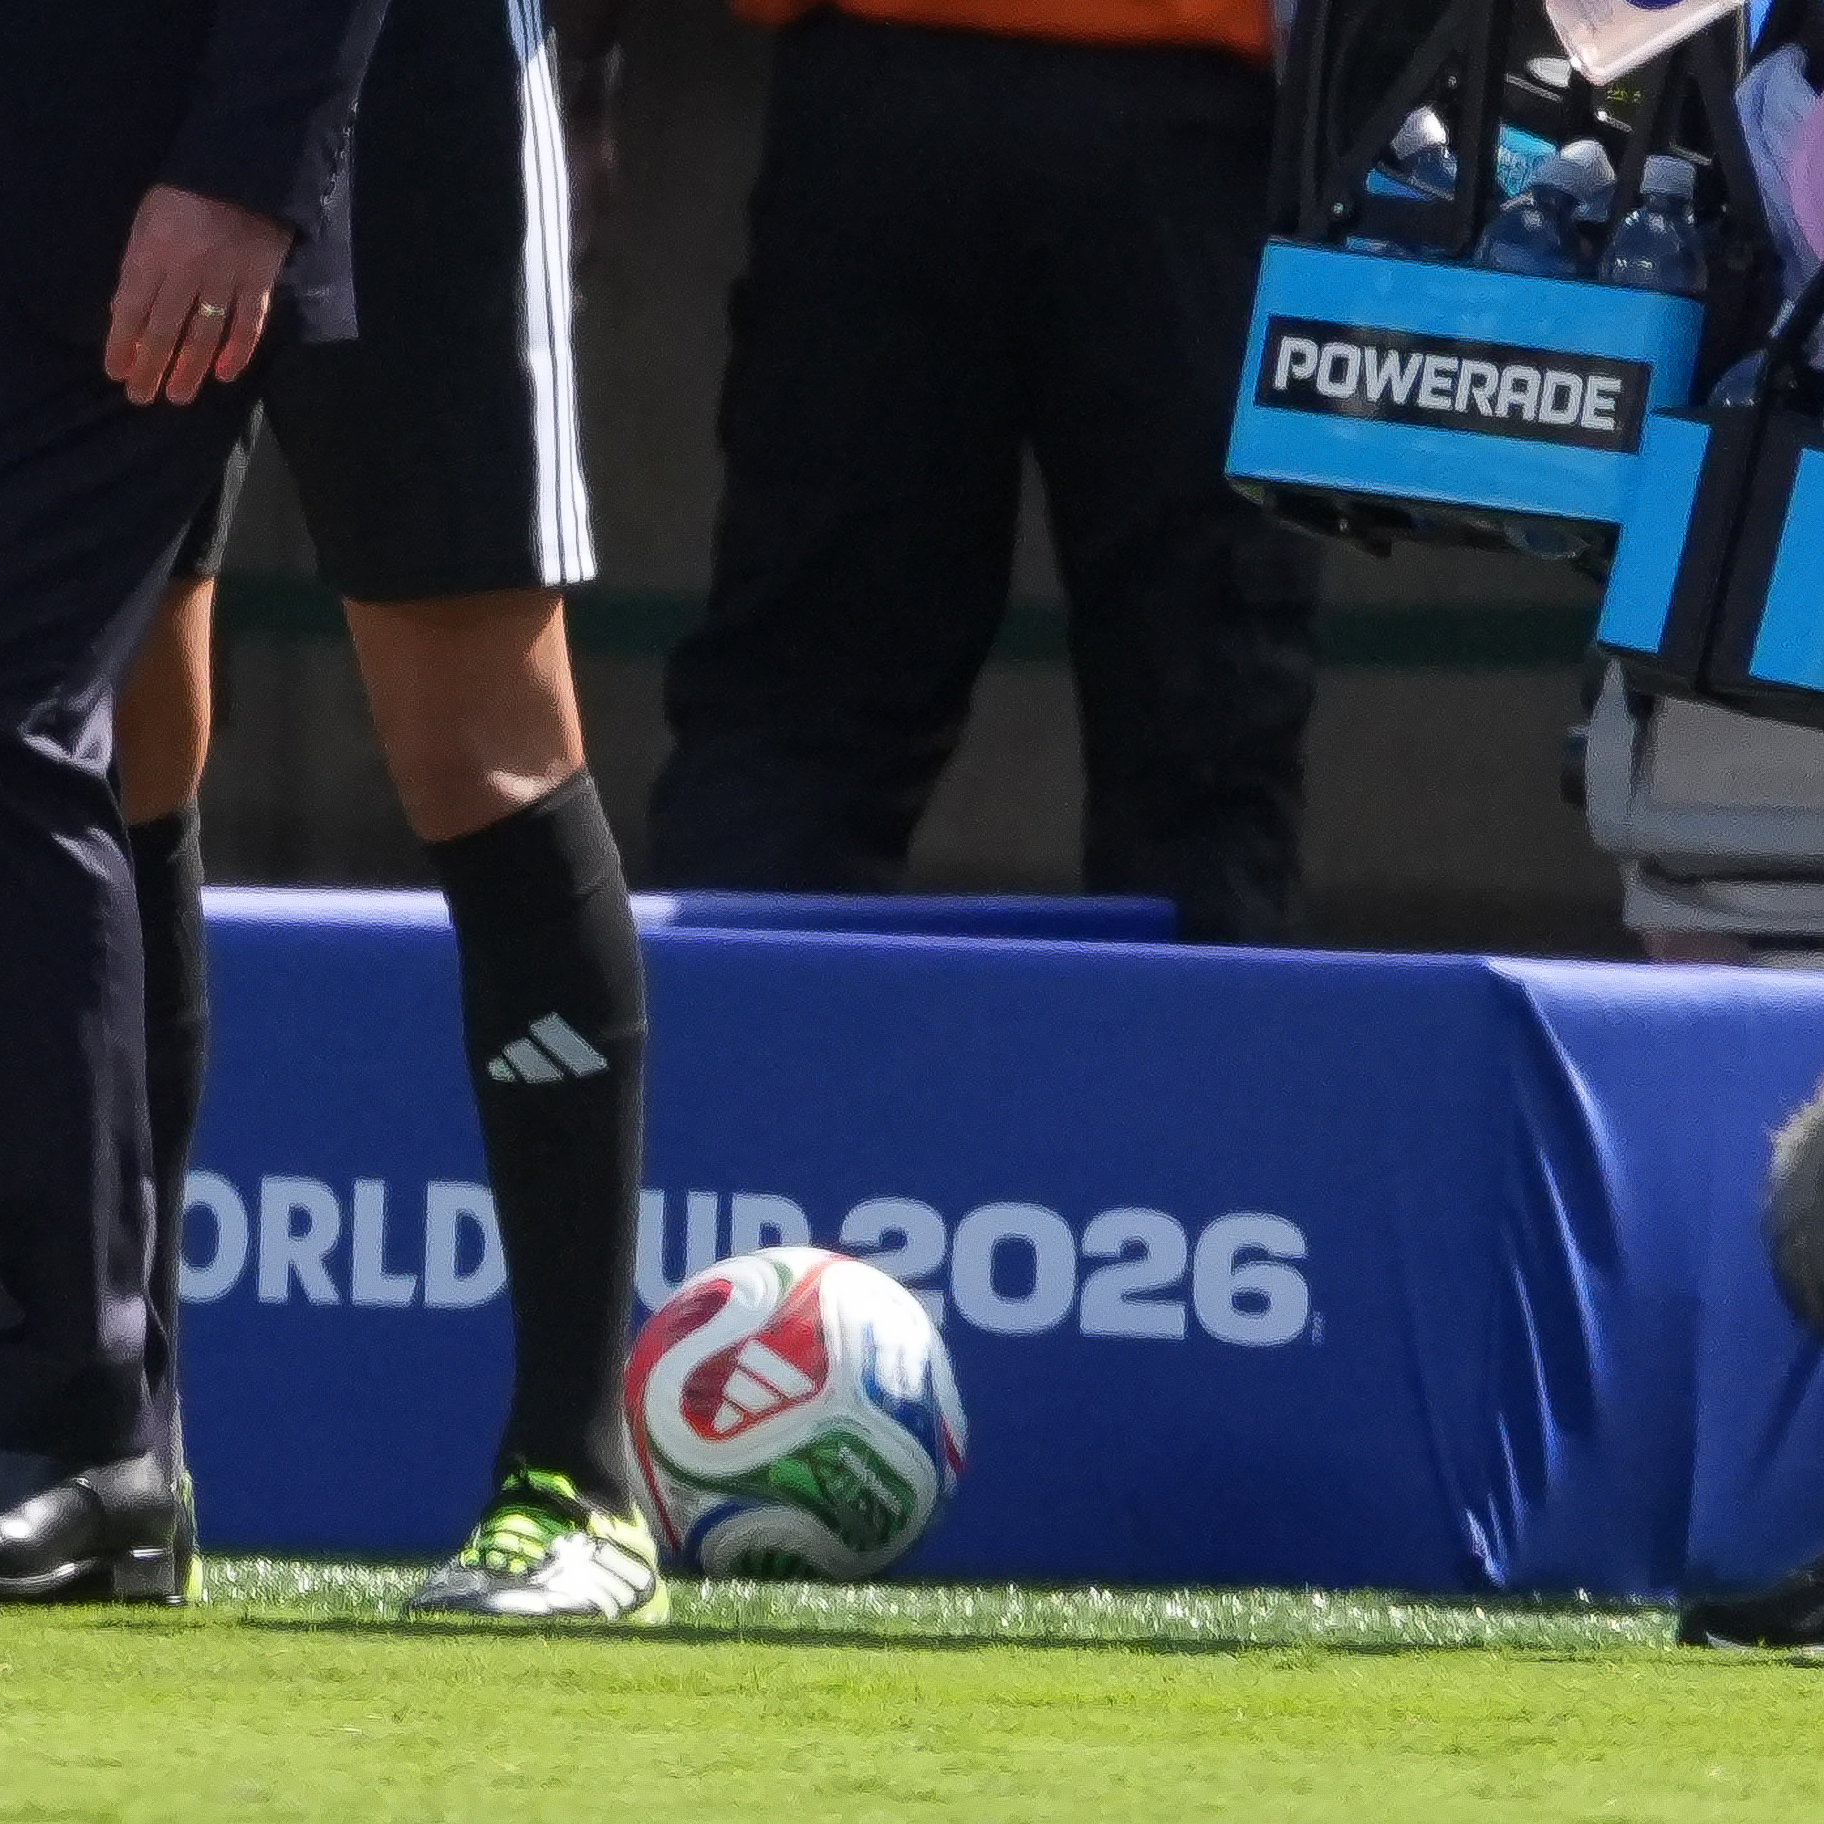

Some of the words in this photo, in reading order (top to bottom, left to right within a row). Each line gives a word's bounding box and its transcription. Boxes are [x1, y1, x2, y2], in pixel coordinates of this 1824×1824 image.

[1273, 335, 1622, 430] POWERADE
[178, 1169, 503, 1307] ORLD
[635, 1189, 811, 1316] UP
[840, 1194, 1309, 1348] 2026
